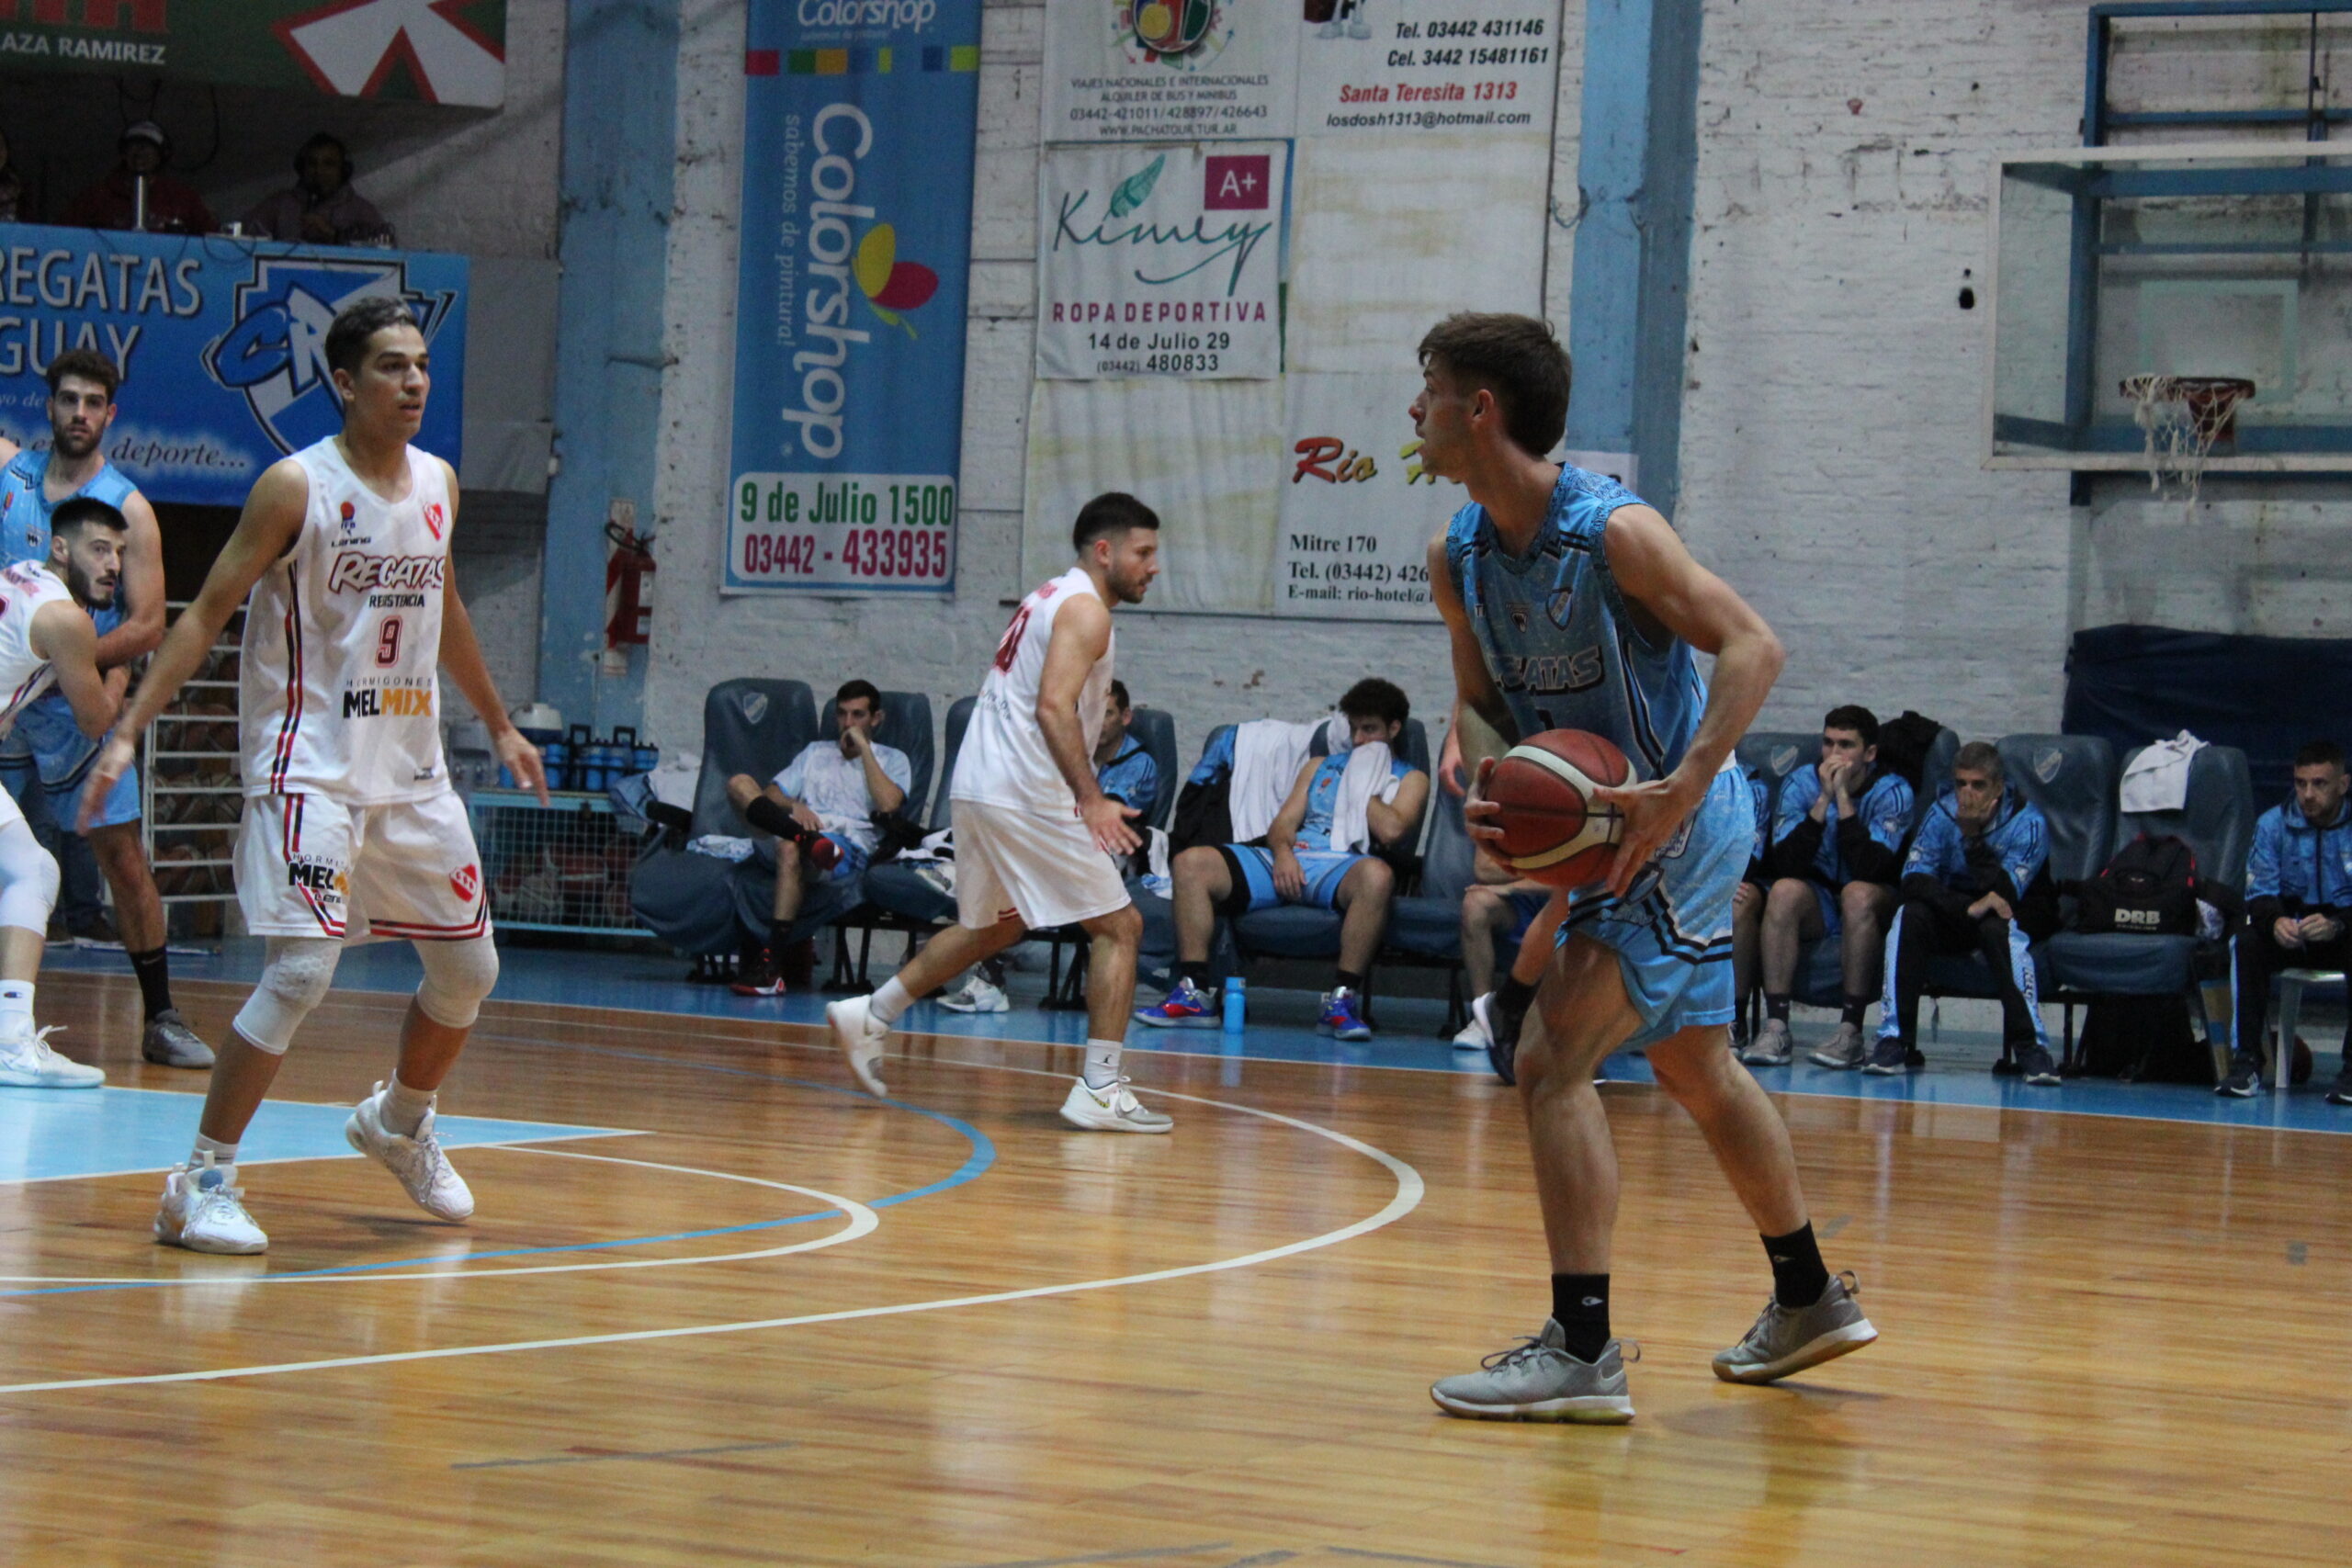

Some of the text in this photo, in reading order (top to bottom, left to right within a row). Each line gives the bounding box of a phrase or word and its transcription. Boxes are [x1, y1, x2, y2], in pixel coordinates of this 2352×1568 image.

[797, 0, 936, 33] Colorshop
[1396, 19, 1544, 39] Tel. 03442 431146
[58, 37, 165, 65] RAMIREZ
[1387, 47, 1549, 66] Cel. 3442 15481161
[1105, 76, 1166, 88] NACIONALES
[1170, 76, 1175, 87] E
[1179, 74, 1269, 86] INTERNACIONALES
[1340, 82, 1518, 102] Santa Teresita 1313
[1101, 91, 1147, 103] ALQUILER
[1150, 91, 1162, 101] DE
[1166, 91, 1185, 101] BUS
[1188, 90, 1193, 100] Y
[1327, 111, 1531, 129] losdosh1313@hotmail.com
[782, 114, 806, 214] sabemos
[1219, 169, 1257, 197] A+
[780, 221, 800, 248] de
[0, 245, 201, 316] EGATAS
[782, 103, 875, 458] Colorshop
[1054, 301, 1266, 321] ROPA DEPORTIVA
[1089, 332, 1230, 350] 14 de Julio 29
[1147, 355, 1219, 372] 480833
[110, 435, 246, 468] deporte...
[741, 480, 954, 525] 9 de Julio 1500
[744, 534, 815, 574] 03442
[842, 529, 947, 578] 433935
[1290, 534, 1376, 552] Mitre 170
[329, 552, 446, 594] REGATAS
[1288, 561, 1319, 580] Tel.
[1325, 563, 1391, 583] (03442)
[1288, 585, 1342, 602] E-mail:
[376, 615, 403, 668] 9
[343, 688, 432, 718] MELMIX
[2114, 908, 2161, 925] DRB
